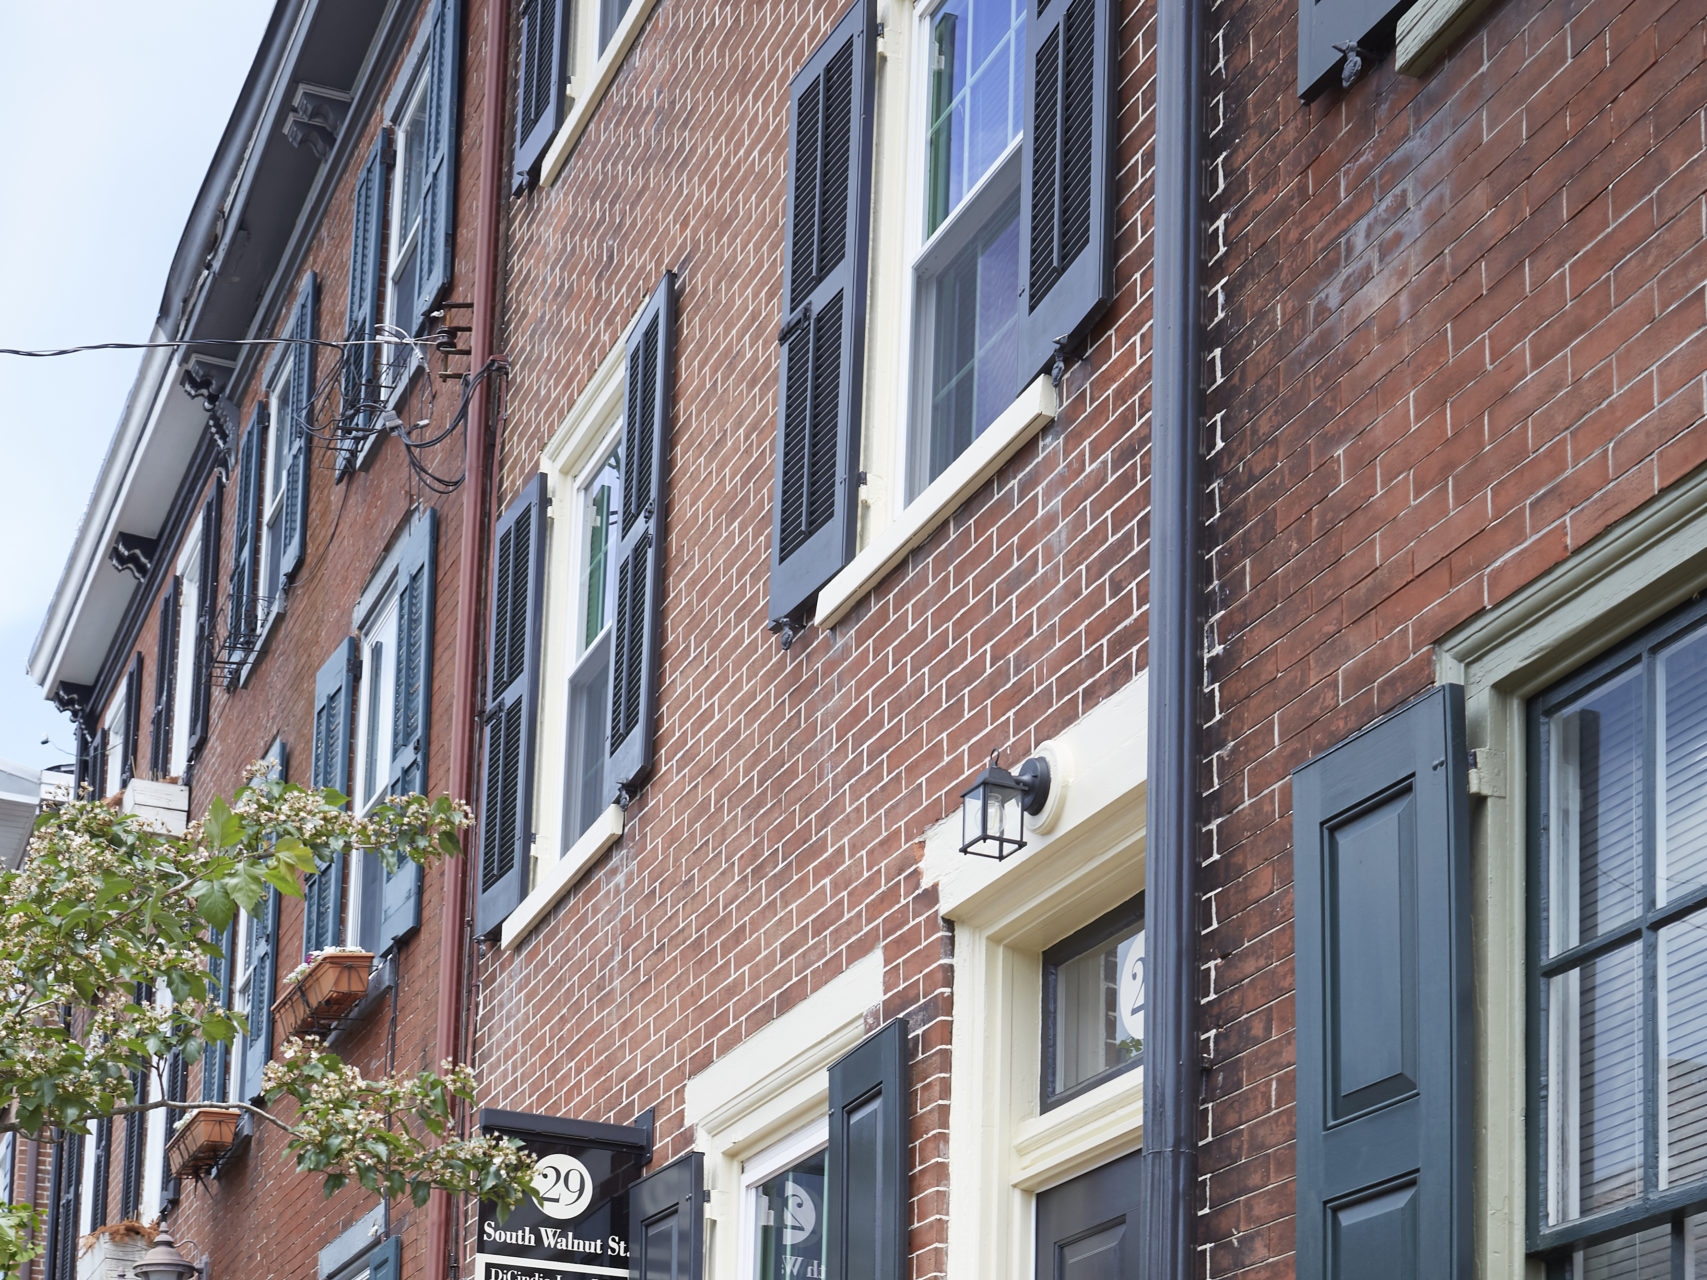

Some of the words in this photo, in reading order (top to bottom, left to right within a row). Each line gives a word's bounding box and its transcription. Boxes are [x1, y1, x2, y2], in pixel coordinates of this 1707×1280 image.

[540, 1165, 585, 1207] 29
[483, 1220, 536, 1246] South
[538, 1226, 602, 1254] Walnut
[607, 1235, 630, 1257] St.
